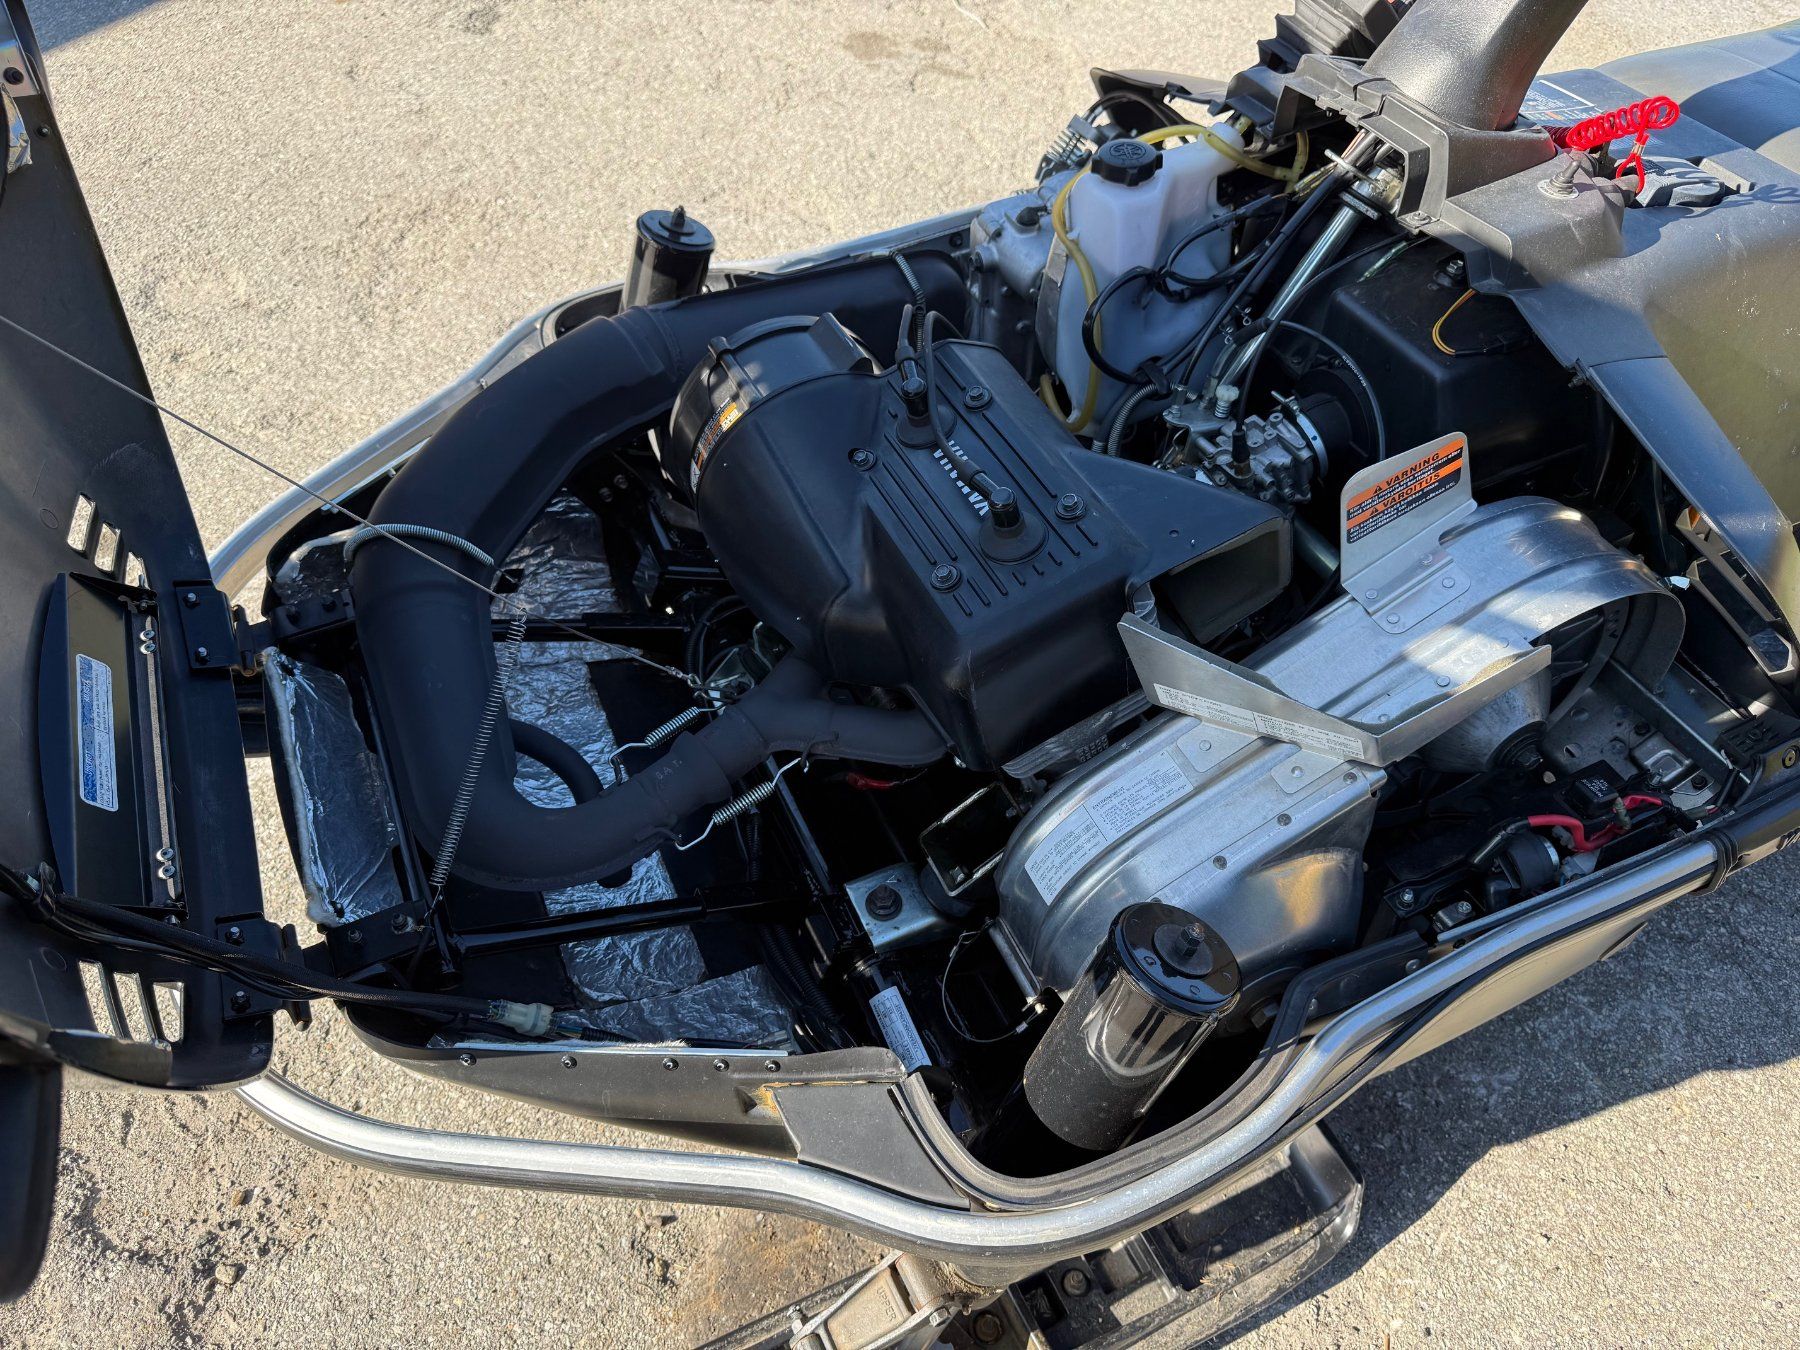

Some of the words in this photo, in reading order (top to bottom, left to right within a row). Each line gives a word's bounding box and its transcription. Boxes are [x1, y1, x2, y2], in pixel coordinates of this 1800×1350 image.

[1385, 453, 1440, 487] VARNING
[1382, 472, 1440, 508] VAROITUS
[877, 1286, 897, 1321] UPPER
